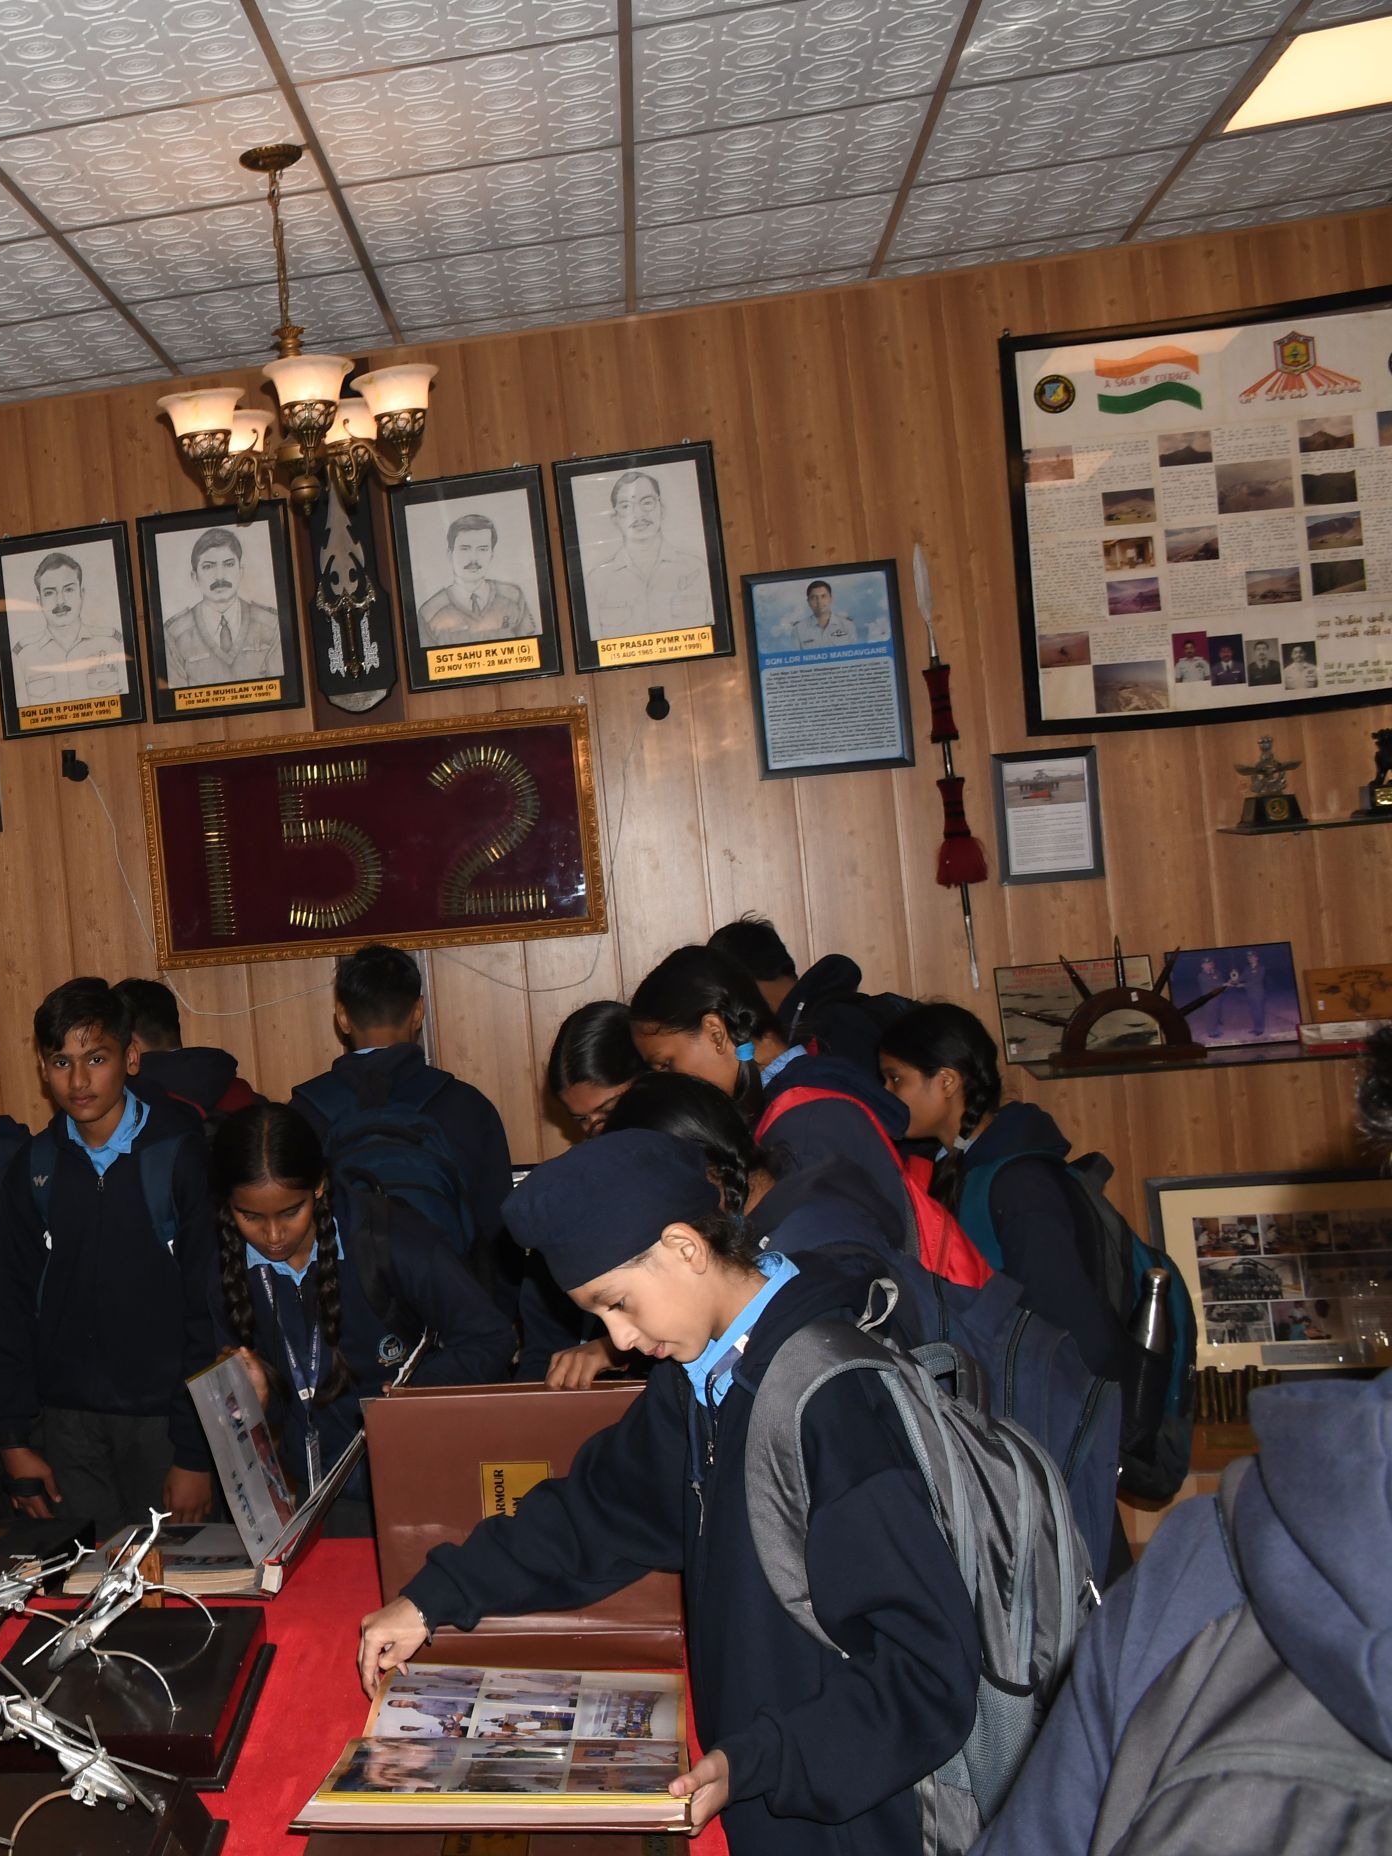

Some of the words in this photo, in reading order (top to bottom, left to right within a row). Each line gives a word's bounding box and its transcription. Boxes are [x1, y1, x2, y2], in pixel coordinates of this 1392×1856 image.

[600, 643, 617, 652] SGT
[620, 639, 654, 650] PRASAD
[656, 635, 680, 645] PVMR
[682, 633, 695, 642] VM
[697, 631, 710, 641] (G)
[435, 653, 454, 663] SGT
[456, 650, 482, 661] SAHU
[485, 648, 498, 657] RK
[500, 646, 514, 655] VM
[517, 644, 530, 655] (G)
[447, 663, 462, 671] NOV
[464, 661, 481, 669] 1971
[487, 659, 496, 667] 28
[515, 655, 534, 663] 1999)
[765, 658, 783, 666] SQN
[784, 656, 800, 664] LDR
[803, 653, 828, 662] NINAD
[830, 646, 888, 659] MANDAVGANE
[178, 692, 192, 700] FLT
[213, 686, 249, 696] MUHILAN
[265, 683, 277, 691] (G)
[21, 709, 37, 718] SQN
[39, 707, 54, 716] LDR
[63, 702, 92, 713] PUNDIR
[94, 700, 106, 709] VM
[108, 698, 119, 708] (G)
[198, 744, 547, 936] 152
[493, 1469, 506, 1515] RMOUR
